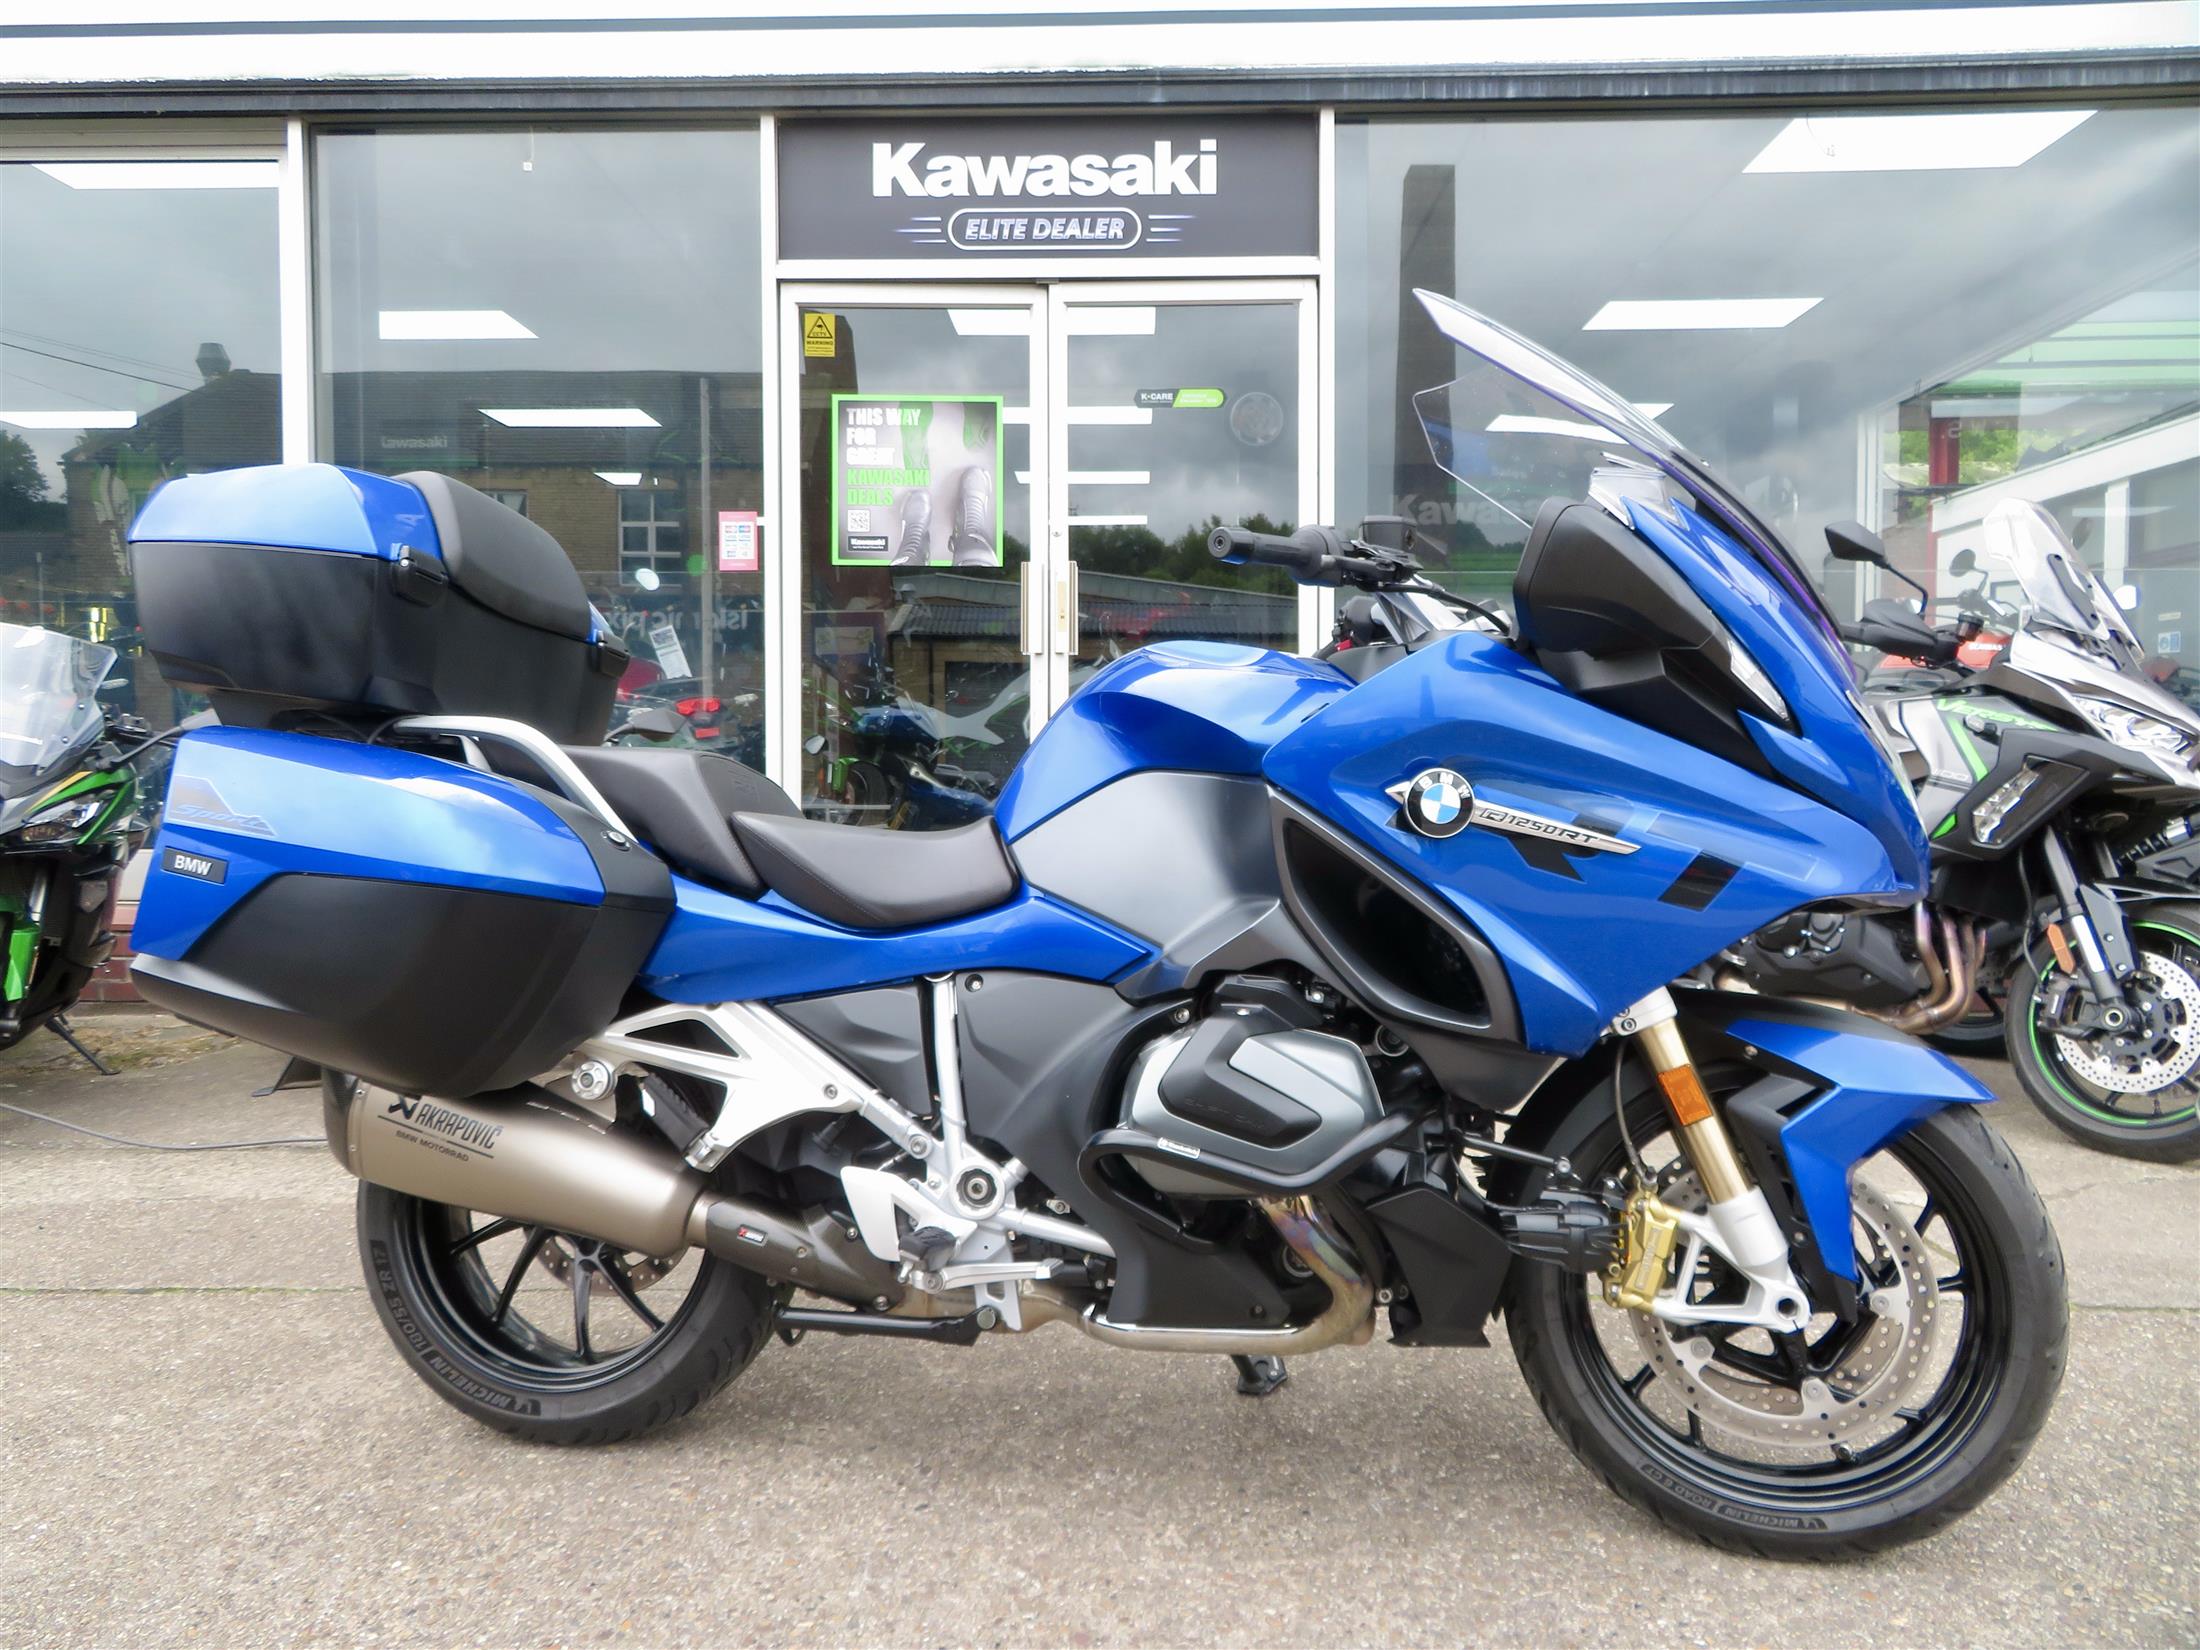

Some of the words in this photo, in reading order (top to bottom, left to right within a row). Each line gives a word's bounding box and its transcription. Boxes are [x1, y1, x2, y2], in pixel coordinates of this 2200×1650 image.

[872, 139, 1218, 197] Kawasaki
[965, 218, 1027, 240] ELITE
[1032, 217, 1125, 239] DEALER
[846, 408, 883, 426] THIS
[885, 408, 921, 426] WAY
[847, 468, 930, 486] KAWASAKI
[847, 488, 894, 506] DEALS
[1418, 773, 1471, 800] BMW
[174, 855, 212, 876] BMW
[419, 1137, 470, 1162] MOTORRAD
[430, 1356, 512, 1409] MICHELIN
[1674, 1485, 1713, 1509] ROAD
[1725, 1507, 1799, 1530] MICHELIN
